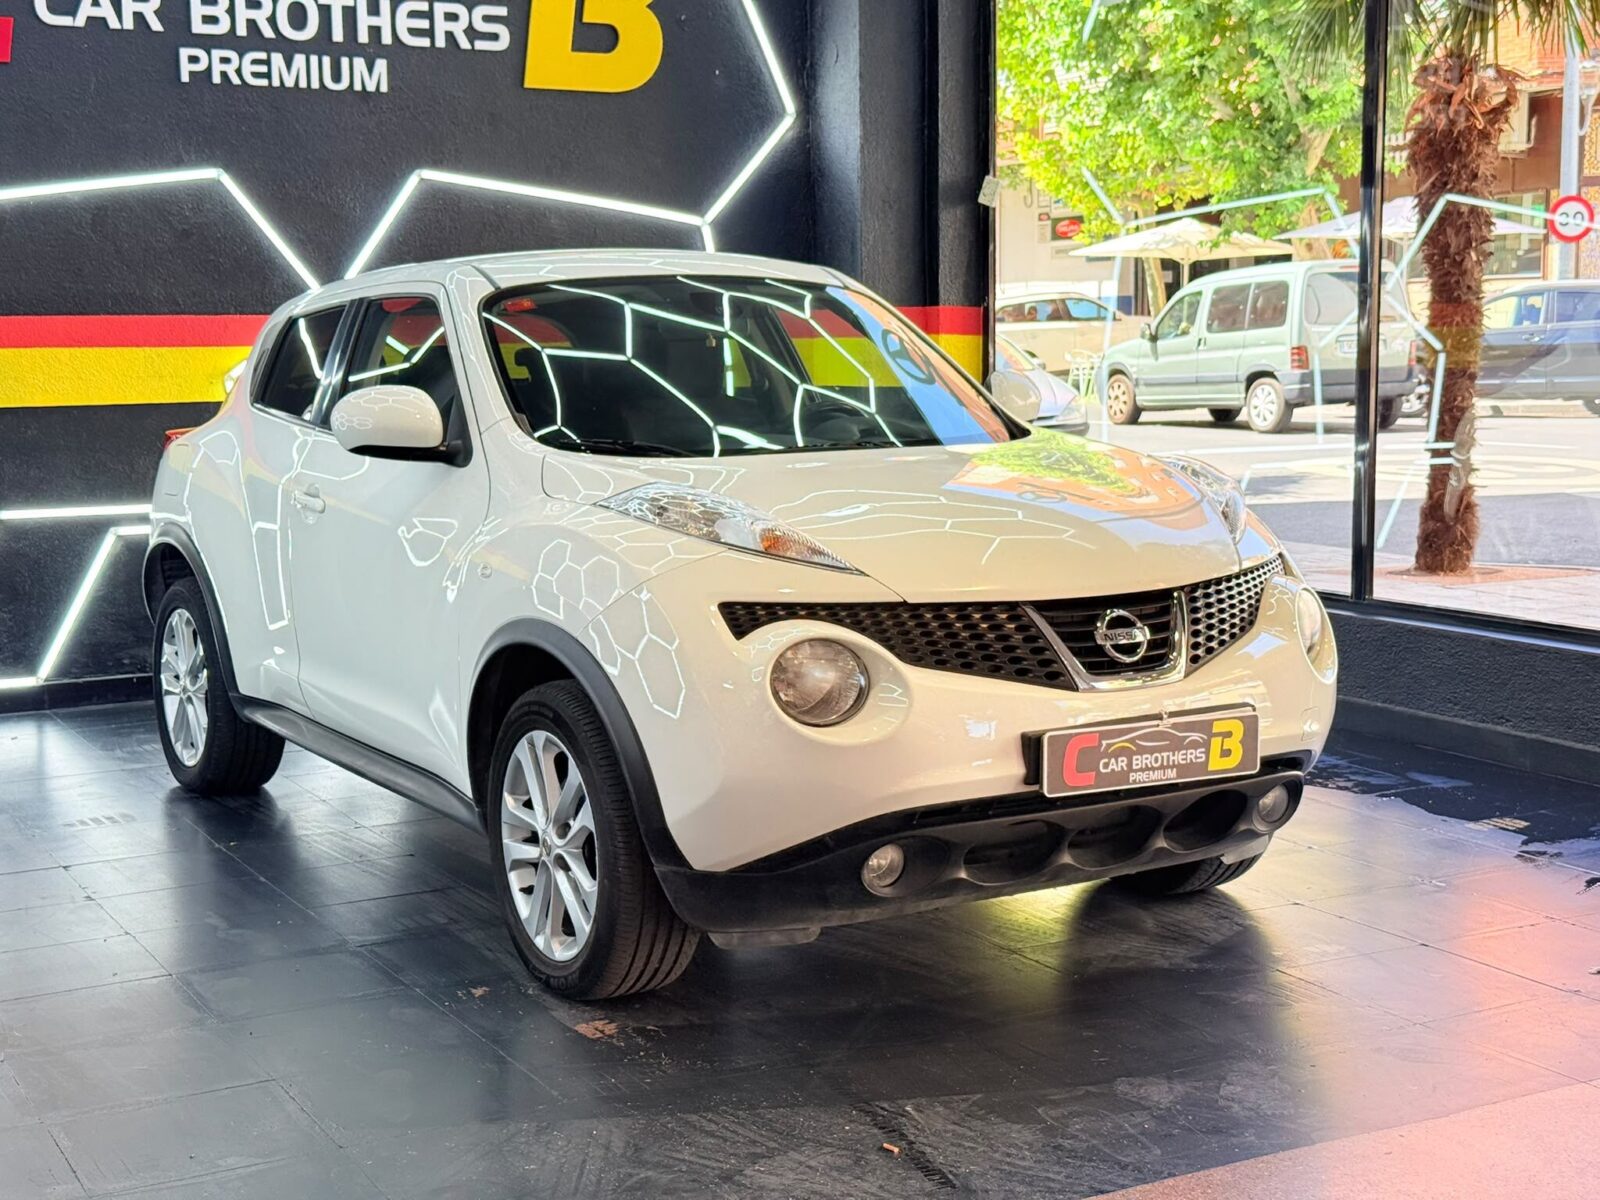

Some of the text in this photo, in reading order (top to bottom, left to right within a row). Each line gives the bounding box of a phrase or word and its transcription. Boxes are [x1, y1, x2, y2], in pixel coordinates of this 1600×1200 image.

[33, 0, 510, 51] CAR BROTHERS
[178, 47, 389, 93] PREMIUM
[1099, 748, 1206, 773] CAR BROTHERS
[1129, 768, 1177, 783] PREMIUM
